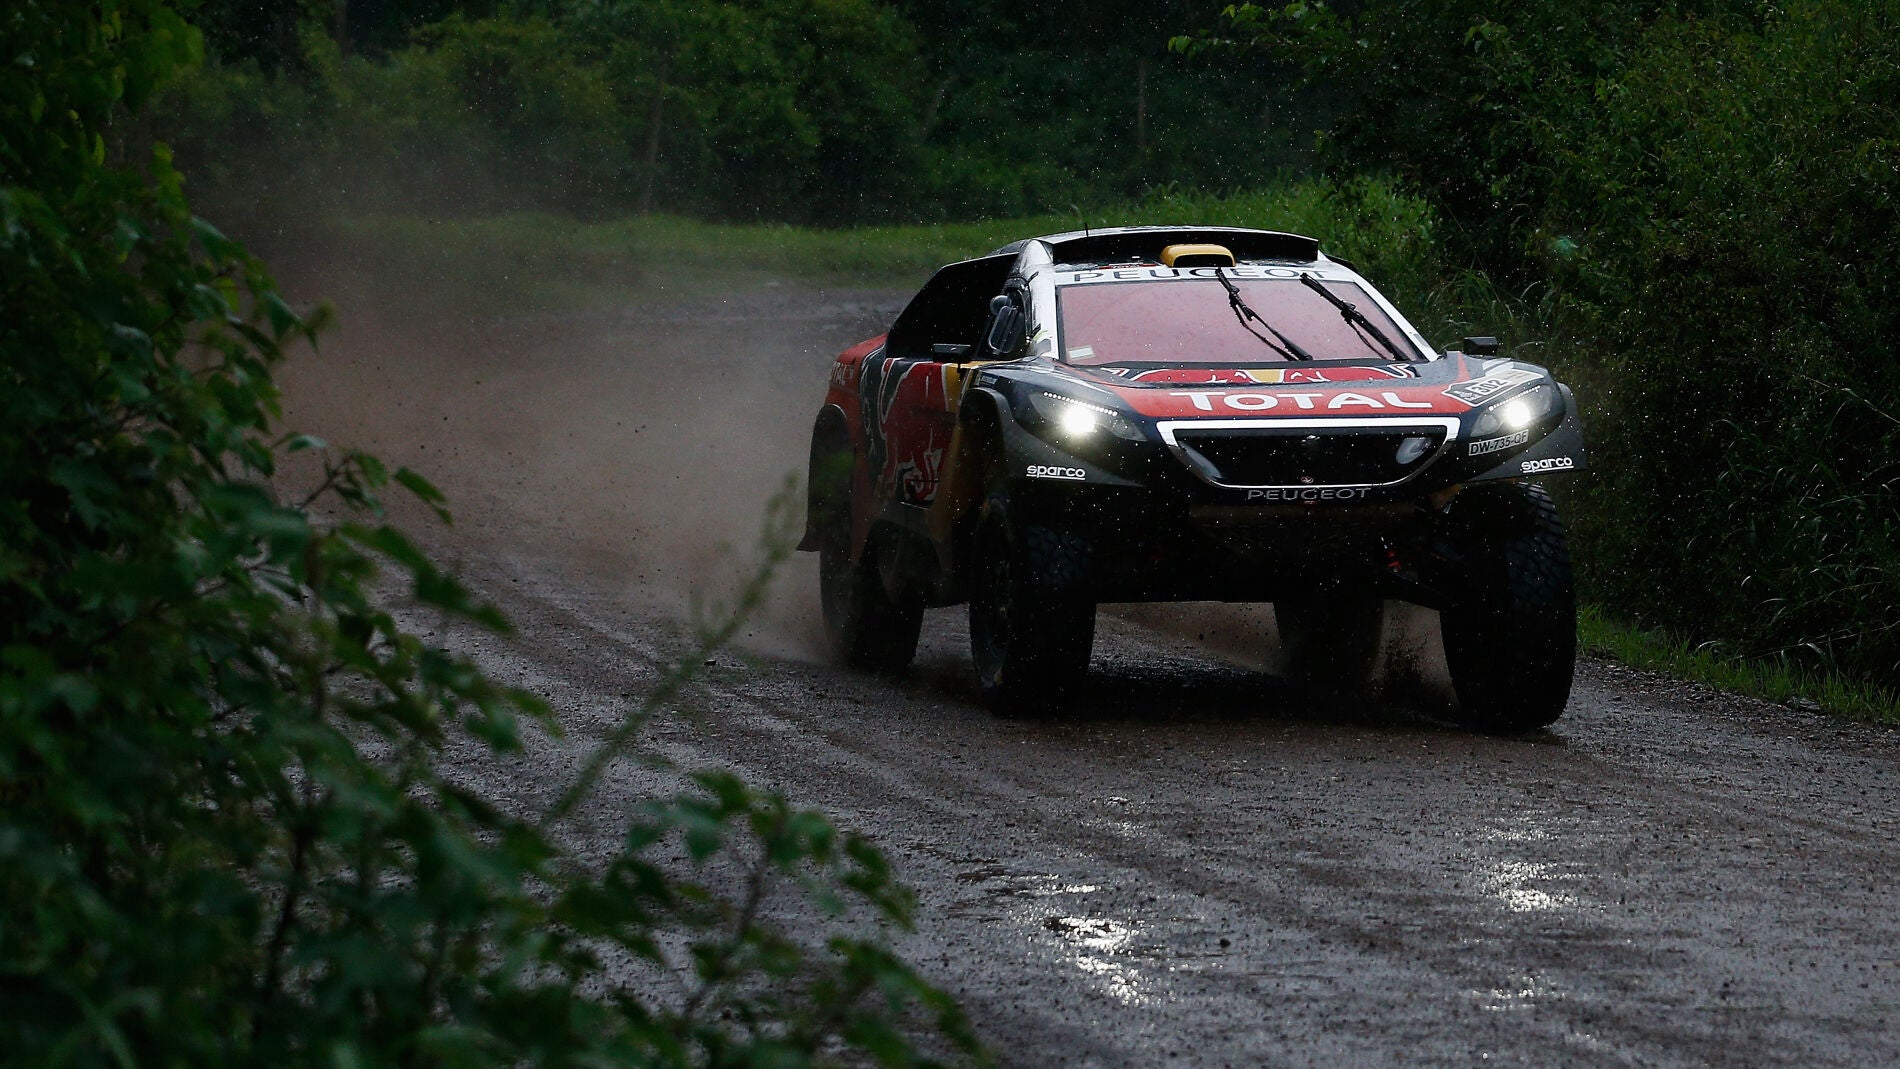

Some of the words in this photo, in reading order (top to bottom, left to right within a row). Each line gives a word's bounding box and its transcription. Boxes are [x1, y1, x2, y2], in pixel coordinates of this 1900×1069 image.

[1074, 267, 1329, 282] PEUGEOT
[1471, 380, 1506, 395] 302
[1171, 392, 1433, 411] TOTAL
[1026, 464, 1086, 480] sparco
[1521, 456, 1573, 473] sparco
[1247, 487, 1370, 501] PEUGEOT
